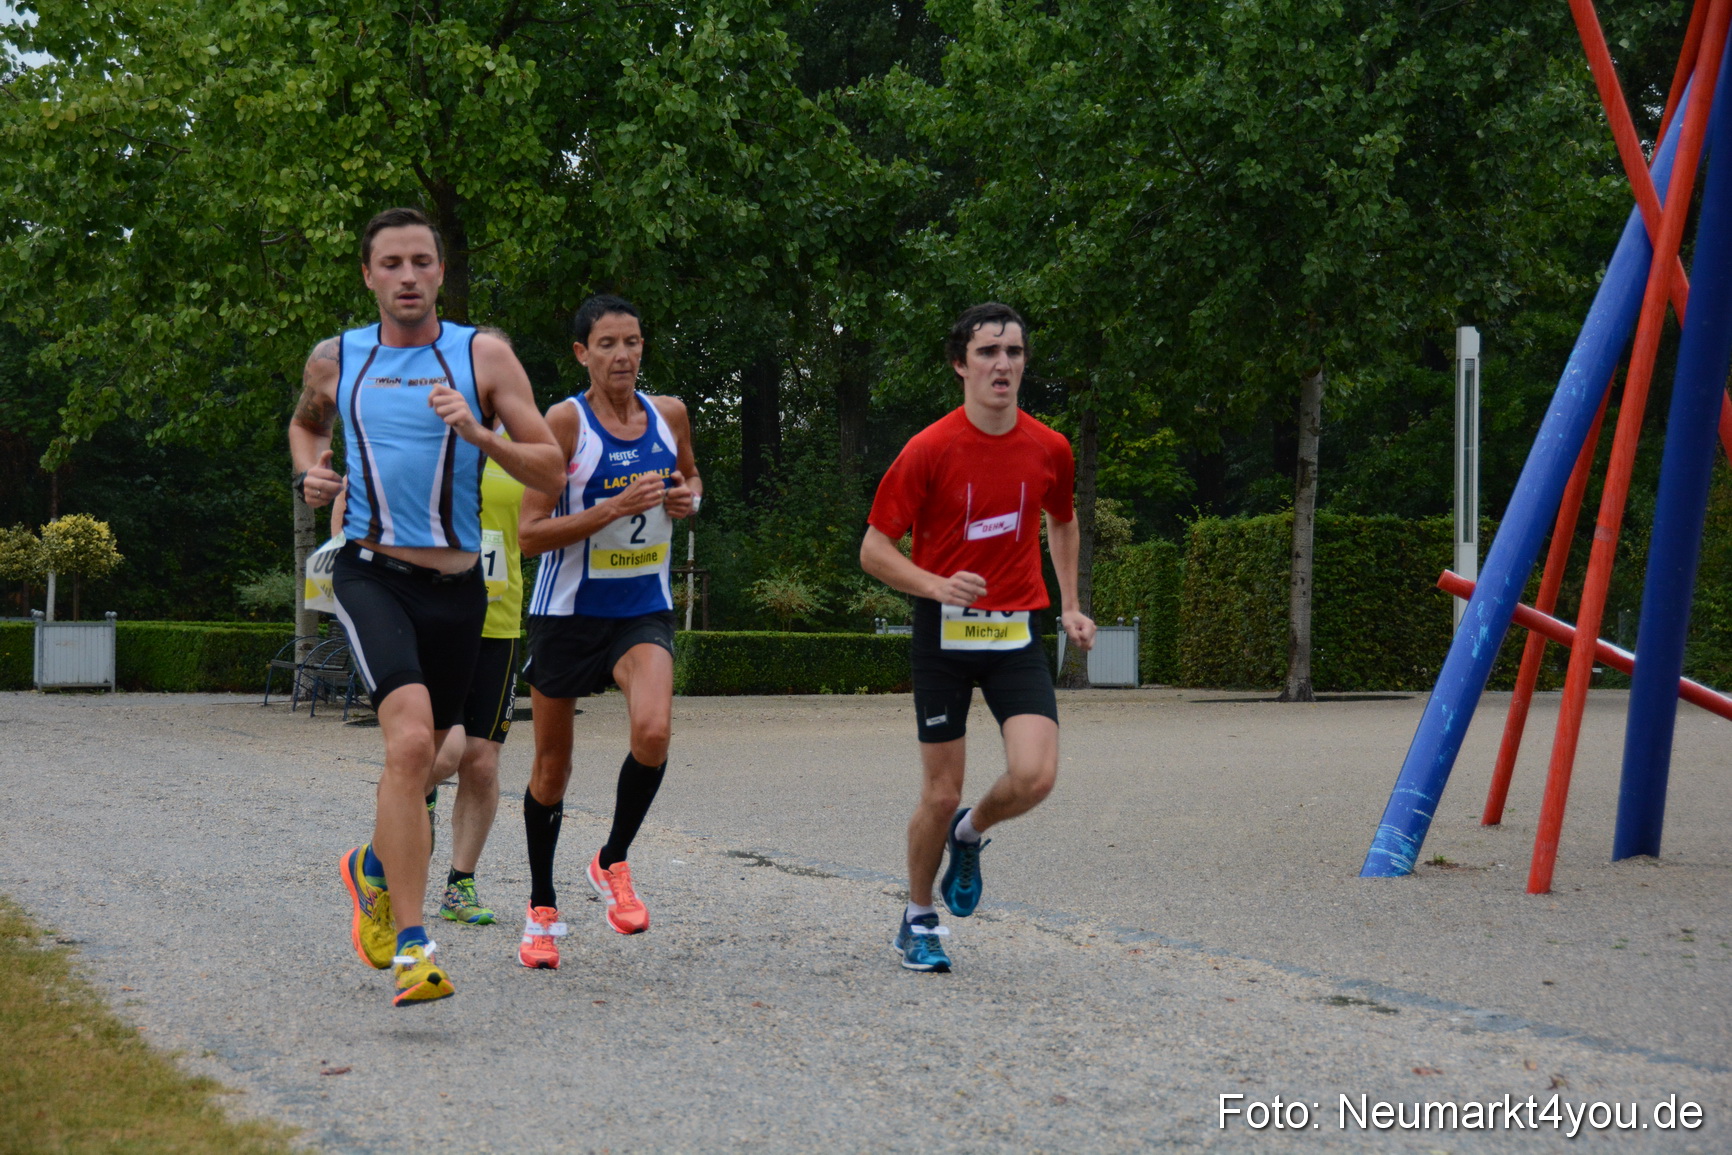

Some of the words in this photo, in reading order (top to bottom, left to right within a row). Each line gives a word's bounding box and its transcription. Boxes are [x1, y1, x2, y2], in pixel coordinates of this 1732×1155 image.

[609, 449, 640, 462] HEITEC
[604, 475, 628, 489] LAC
[630, 513, 647, 545] 2
[610, 551, 658, 567] Christine
[964, 625, 1008, 638] Michael
